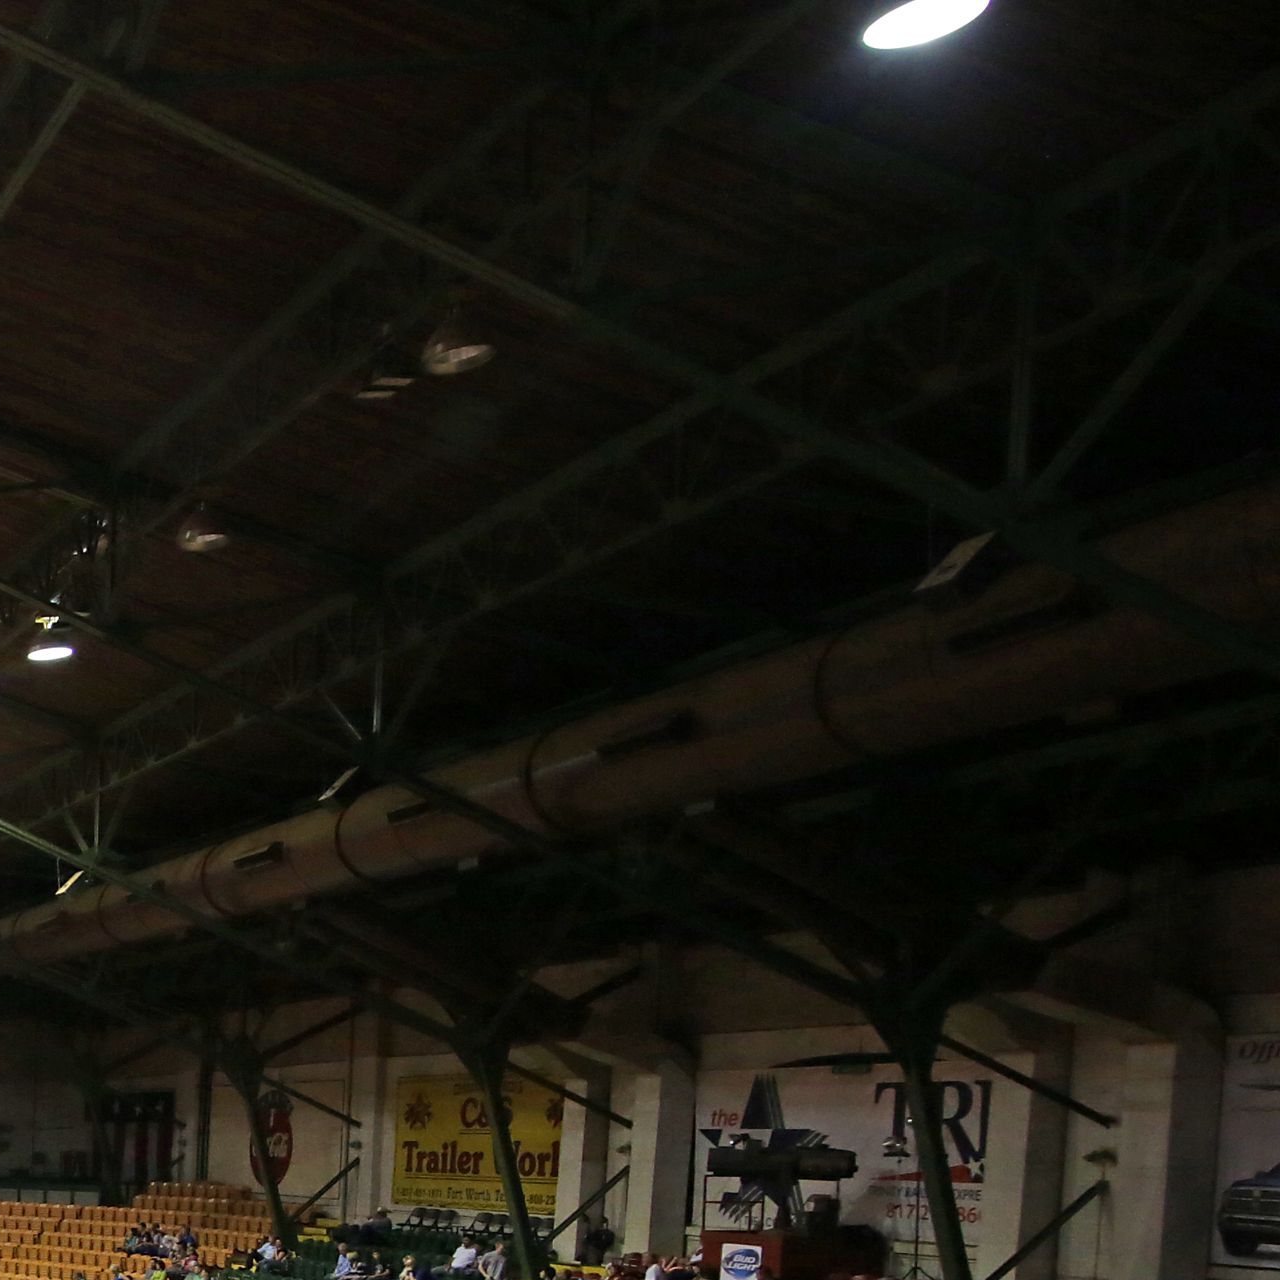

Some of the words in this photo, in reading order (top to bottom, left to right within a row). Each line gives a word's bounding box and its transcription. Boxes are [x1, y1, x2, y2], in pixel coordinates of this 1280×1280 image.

[710, 1109, 738, 1127] the
[401, 1140, 485, 1175] Trailer
[732, 1254, 757, 1263] BUD
[725, 1262, 759, 1271] LIGHT
